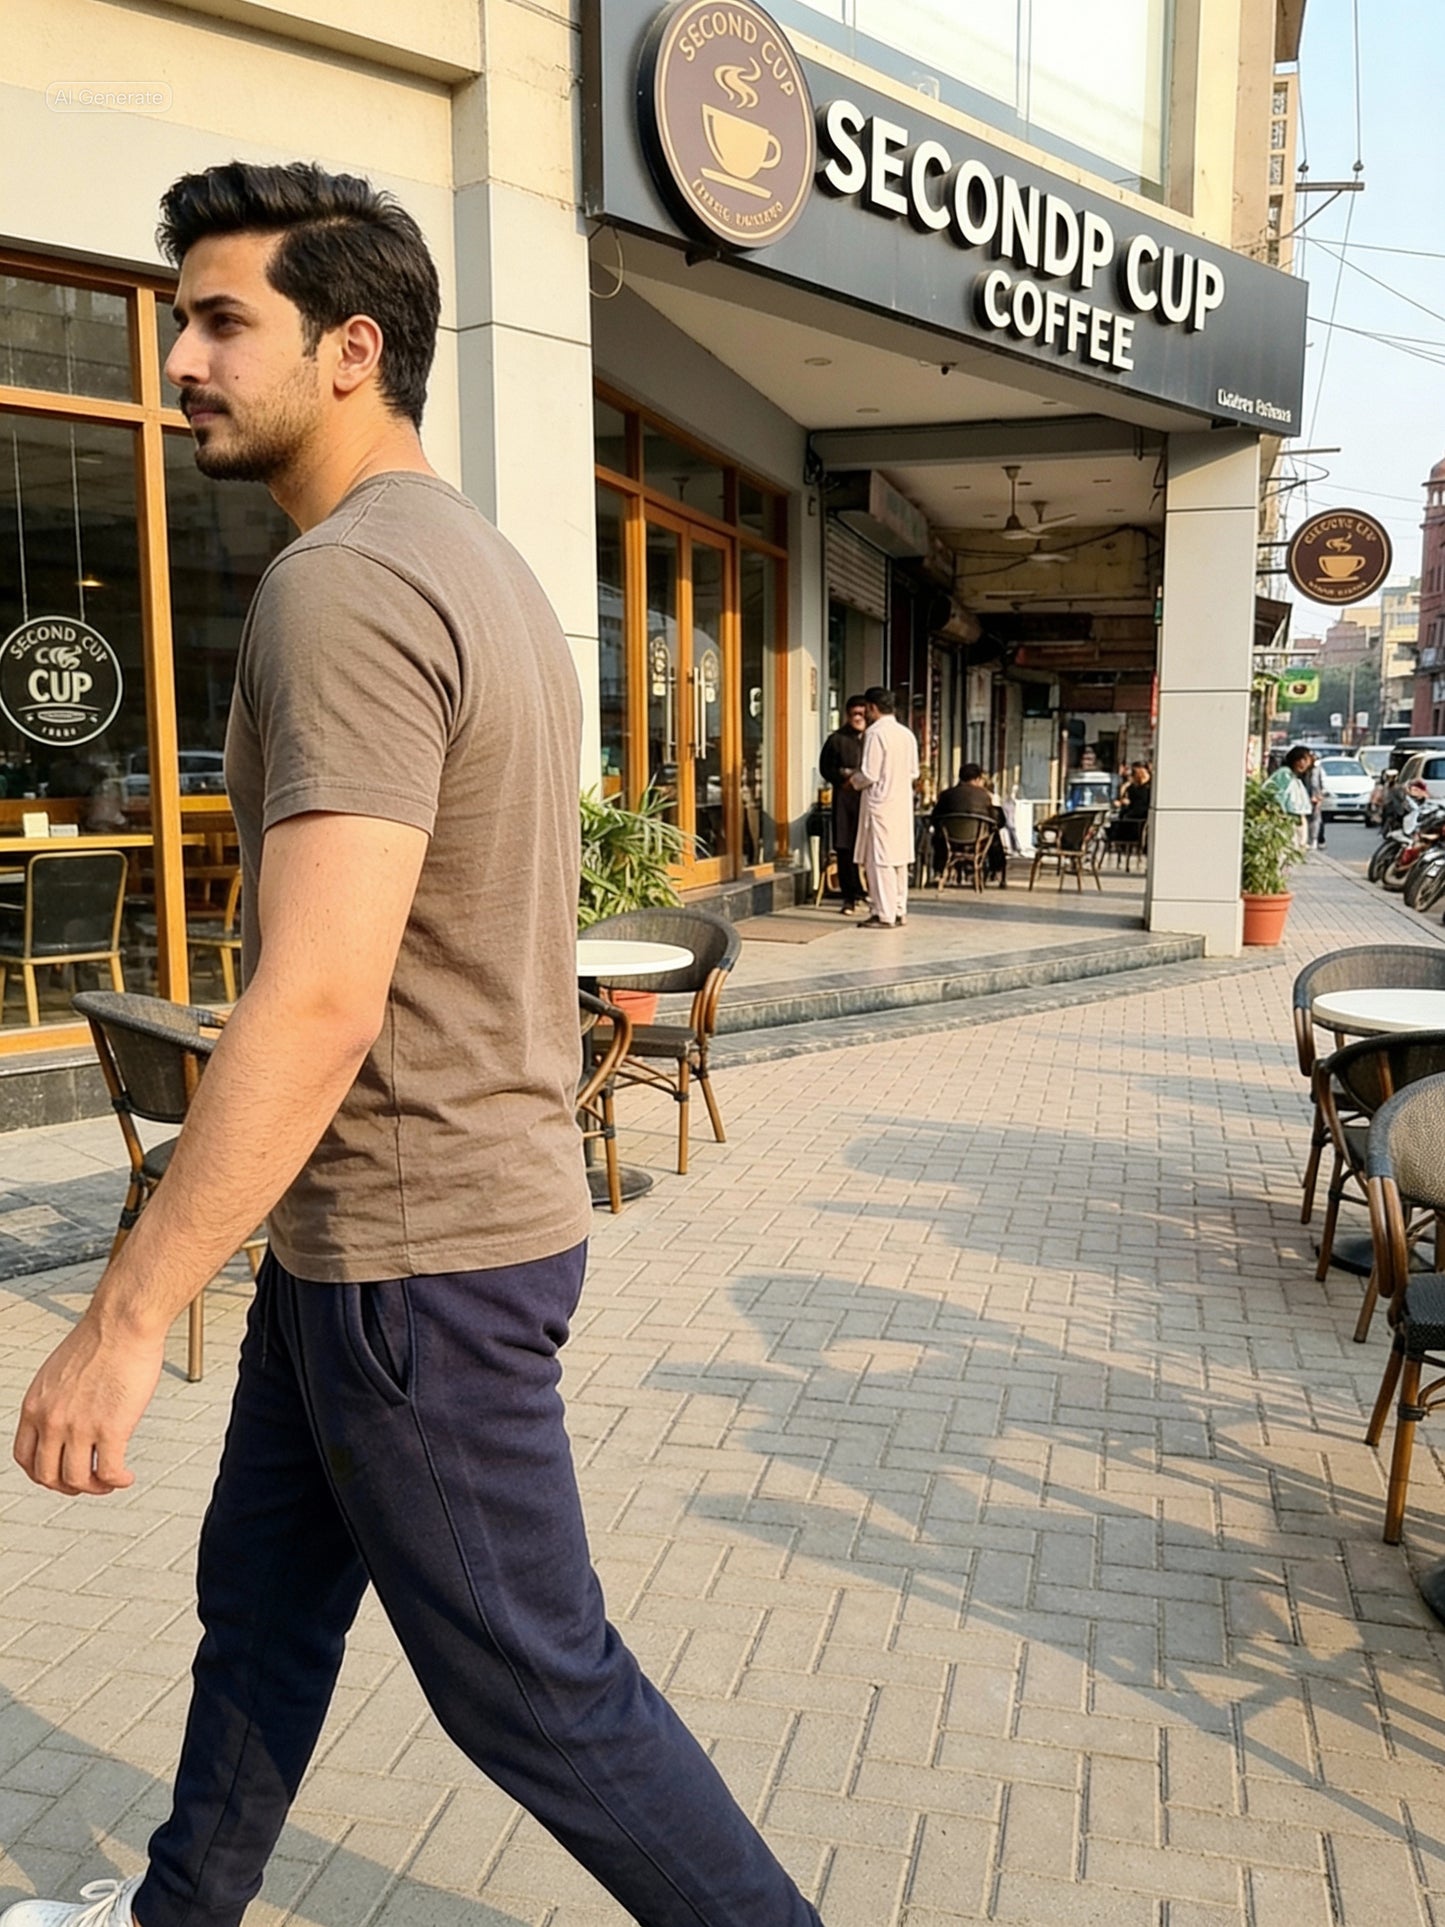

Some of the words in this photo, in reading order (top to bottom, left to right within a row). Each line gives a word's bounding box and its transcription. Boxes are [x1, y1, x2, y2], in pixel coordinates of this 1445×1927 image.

[679, 11, 757, 61] SECOND
[761, 41, 795, 96] CUP
[825, 99, 1114, 288] SECONDP
[1126, 233, 1225, 331] CUP
[983, 269, 1135, 371] COFFEE
[10, 625, 77, 660] SECOND
[28, 668, 93, 703] CUP
